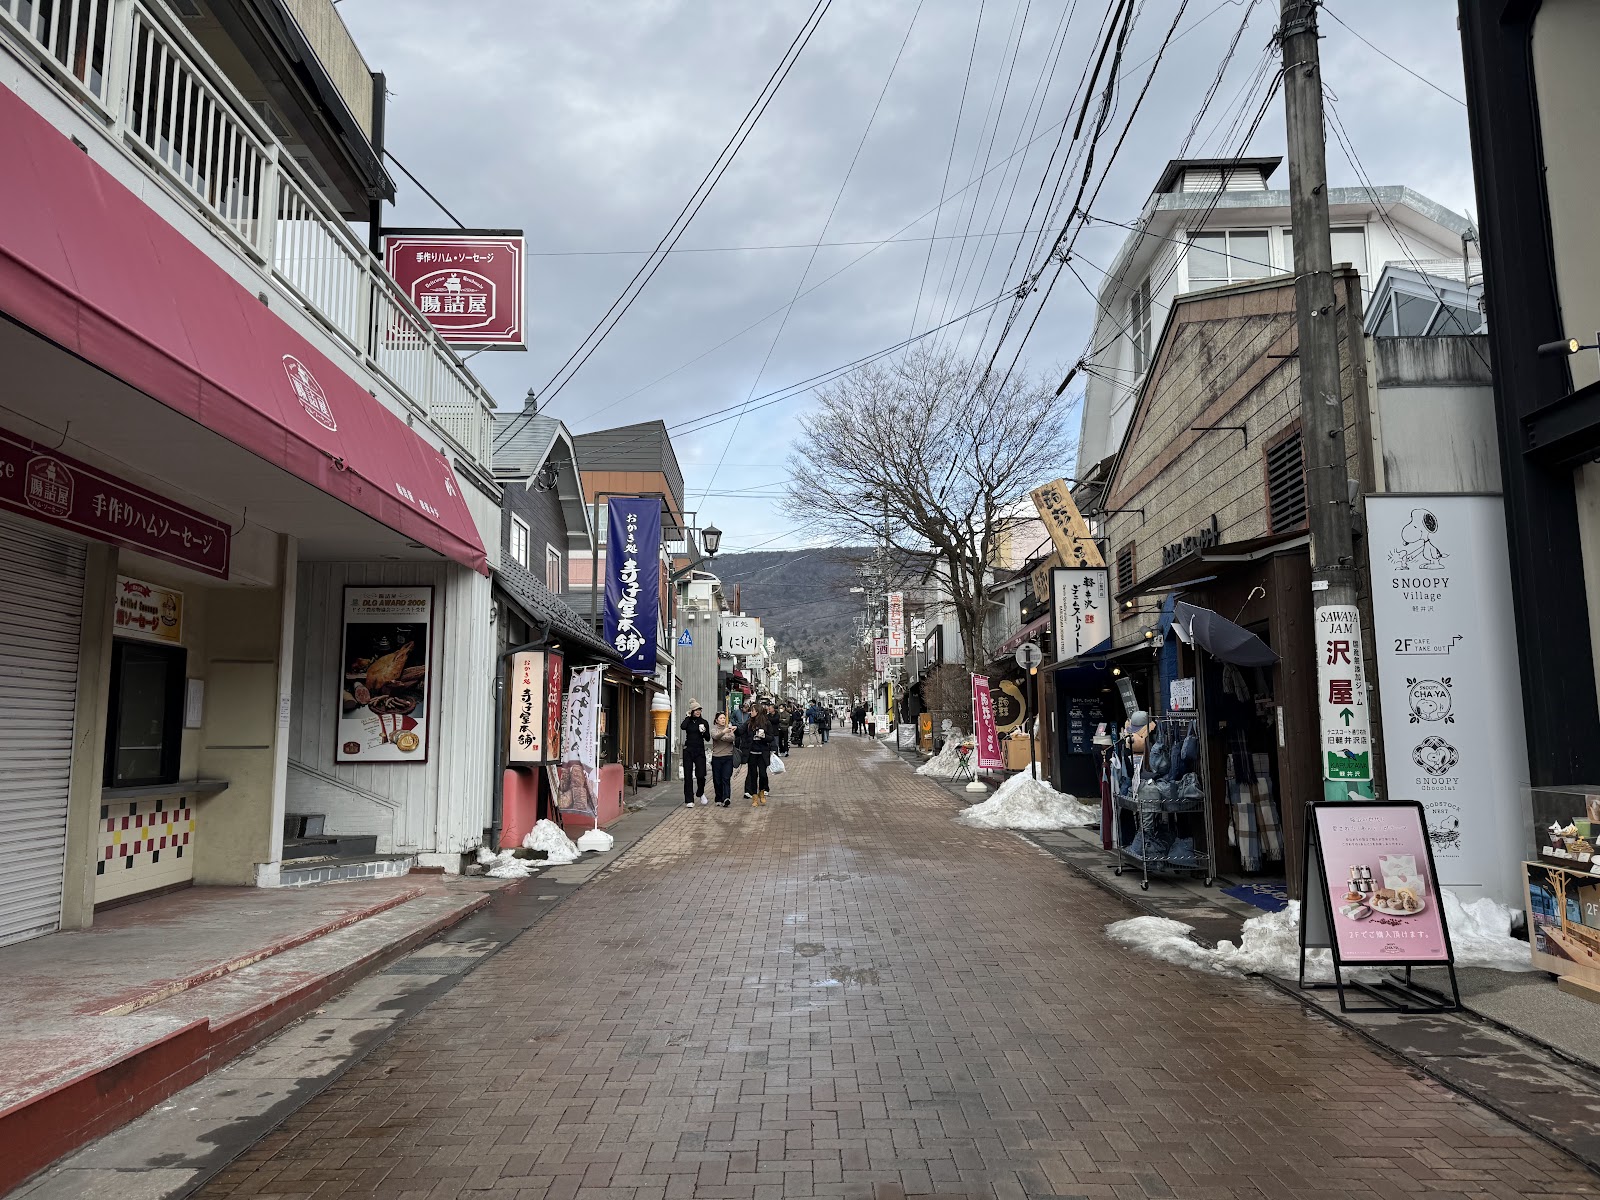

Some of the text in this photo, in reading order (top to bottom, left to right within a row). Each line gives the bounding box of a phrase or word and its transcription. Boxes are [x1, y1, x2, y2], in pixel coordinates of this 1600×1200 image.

[416, 251, 494, 263] 手作りハム・ソーセージ
[420, 295, 487, 313] 腸詰屋
[30, 476, 70, 507] 腸詰屋
[92, 492, 214, 555] 手作りハムソーセージ
[614, 512, 646, 660] おかき処 寺子屋本舗
[1392, 577, 1449, 589] SNOOPY
[1083, 575, 1099, 610] 軽井沢
[1403, 591, 1442, 602] Village
[726, 620, 749, 628] そば処
[1069, 584, 1083, 653] デニムストリート
[1320, 611, 1358, 623] SAWAYA
[1329, 623, 1353, 634] JAM
[730, 635, 757, 650] にし川
[1394, 638, 1413, 652] 2F
[1326, 640, 1354, 705] 沢屋
[517, 660, 537, 751] おかき処 寺子屋本舗
[1327, 736, 1368, 745] 旧軽井沢店
[1416, 777, 1459, 785] SNOOPY
[1423, 801, 1461, 812] OODSTOCK
[1586, 902, 1599, 916] 2F
[1349, 930, 1429, 939] 2Fでご購入頂けます。
